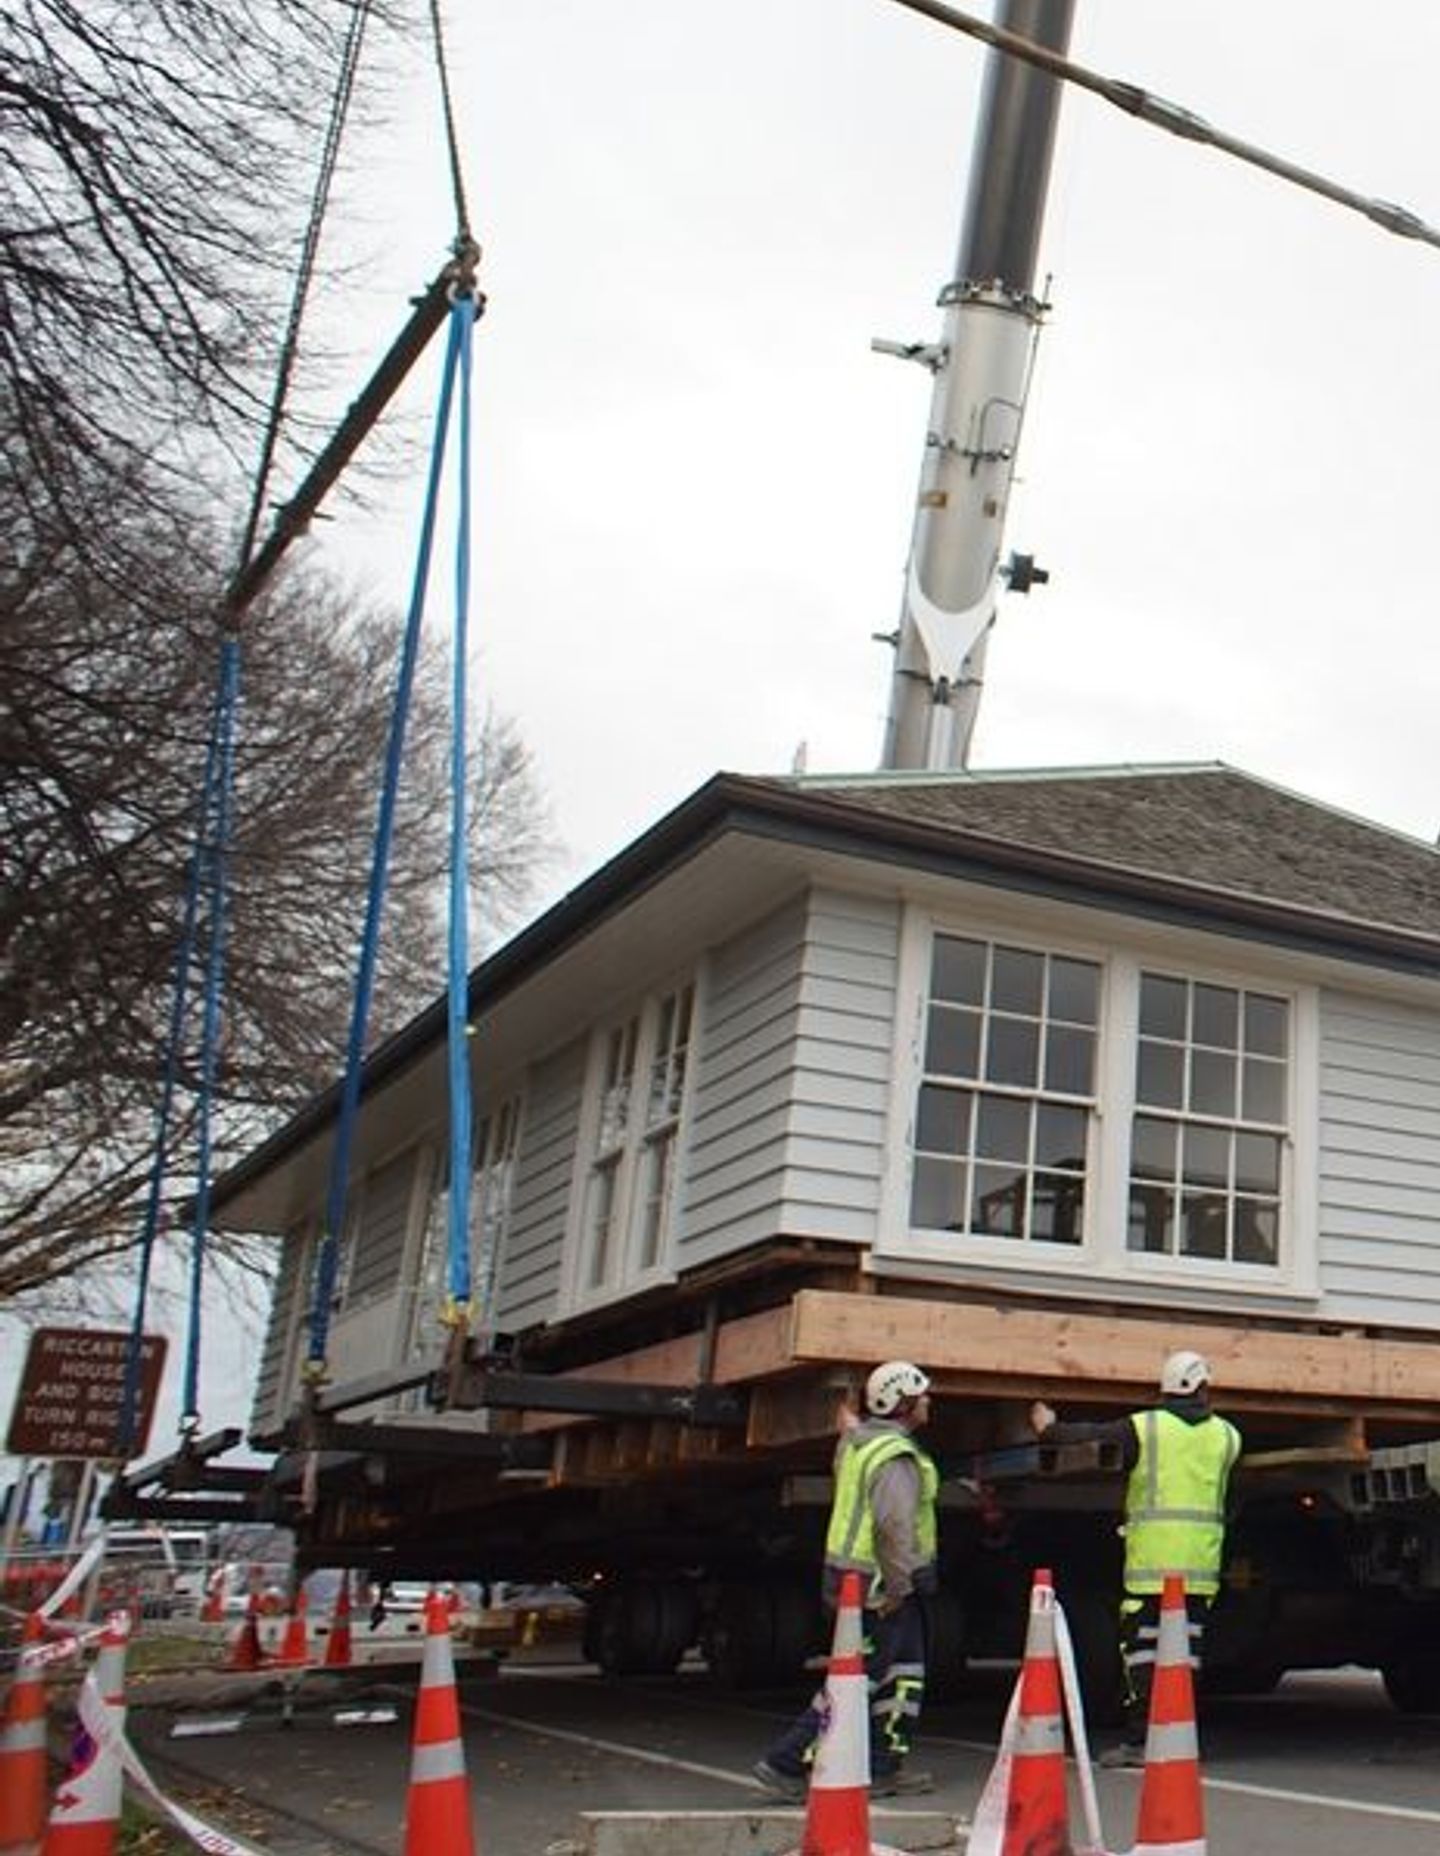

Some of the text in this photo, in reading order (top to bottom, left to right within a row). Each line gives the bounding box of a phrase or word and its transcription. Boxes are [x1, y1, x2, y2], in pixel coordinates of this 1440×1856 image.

[43, 1337, 154, 1359] RICCARTN
[59, 1361, 127, 1380] HOUSE
[35, 1383, 79, 1400] AND
[24, 1406, 143, 1428] TURN RIGT
